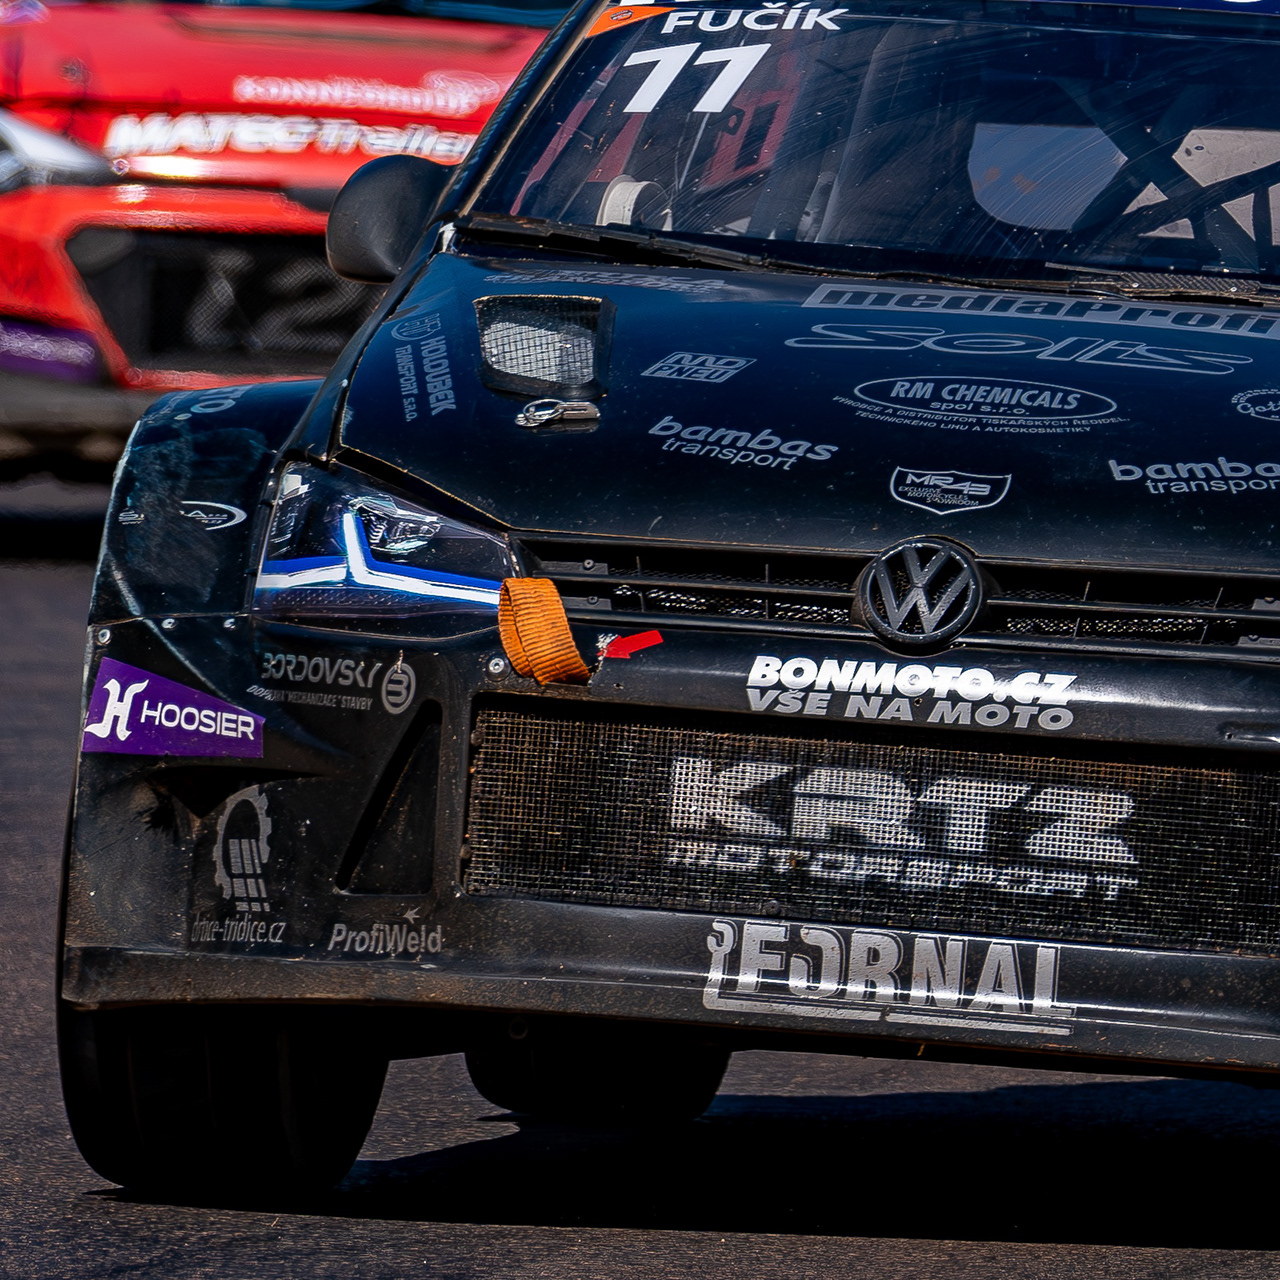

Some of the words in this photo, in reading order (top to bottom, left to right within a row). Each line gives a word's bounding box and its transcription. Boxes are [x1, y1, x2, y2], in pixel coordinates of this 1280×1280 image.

[661, 2, 850, 33] FUČÍK
[623, 43, 771, 112] 11
[395, 344, 418, 395] TRANSPORT
[420, 335, 457, 416] HOLOUBEK
[655, 365, 728, 381] PNEU
[890, 381, 934, 399] RM
[941, 383, 1081, 409] CHEMICALS
[648, 415, 839, 460] bambas
[896, 410, 977, 423] DISTRIBUTOR
[662, 437, 797, 470] transport
[746, 655, 1078, 706] BONMOTO.CZ
[140, 700, 254, 740] HOOSIER
[746, 688, 832, 716] VŠE
[844, 695, 913, 721] NA
[927, 700, 1074, 730] MOTO
[670, 757, 1137, 864] KRTZ
[668, 840, 1139, 900] MOTORSPORT
[327, 923, 442, 953] ProfiWeld
